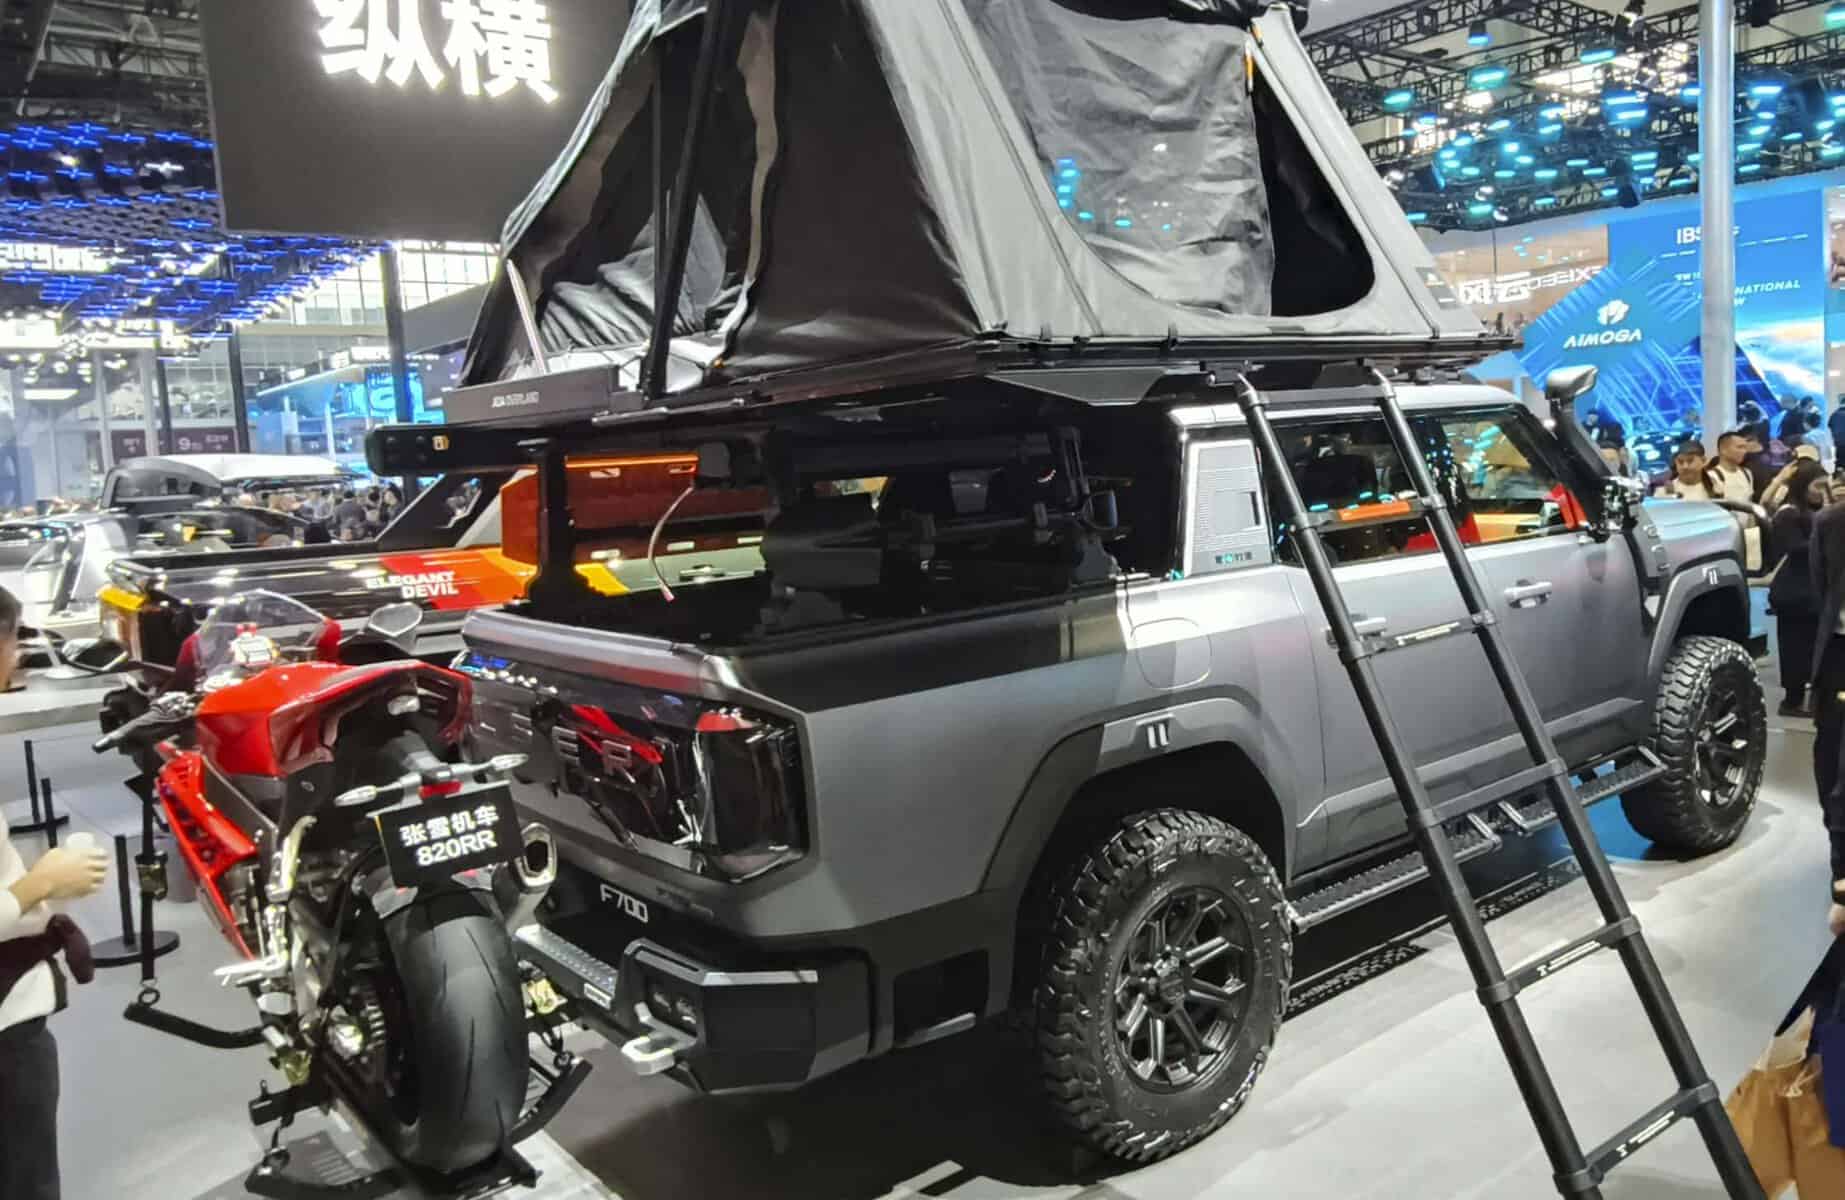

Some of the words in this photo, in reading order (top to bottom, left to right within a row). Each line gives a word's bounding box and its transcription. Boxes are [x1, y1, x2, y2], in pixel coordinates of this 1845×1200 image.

[314, 0, 560, 104] 纵横
[1563, 328, 1643, 349] AIMOGA
[366, 569, 455, 590] ELEGANT
[402, 581, 459, 600] DEVIL
[399, 804, 499, 847] 张雪机车
[416, 829, 498, 867] 820RR
[600, 883, 649, 924] F700
